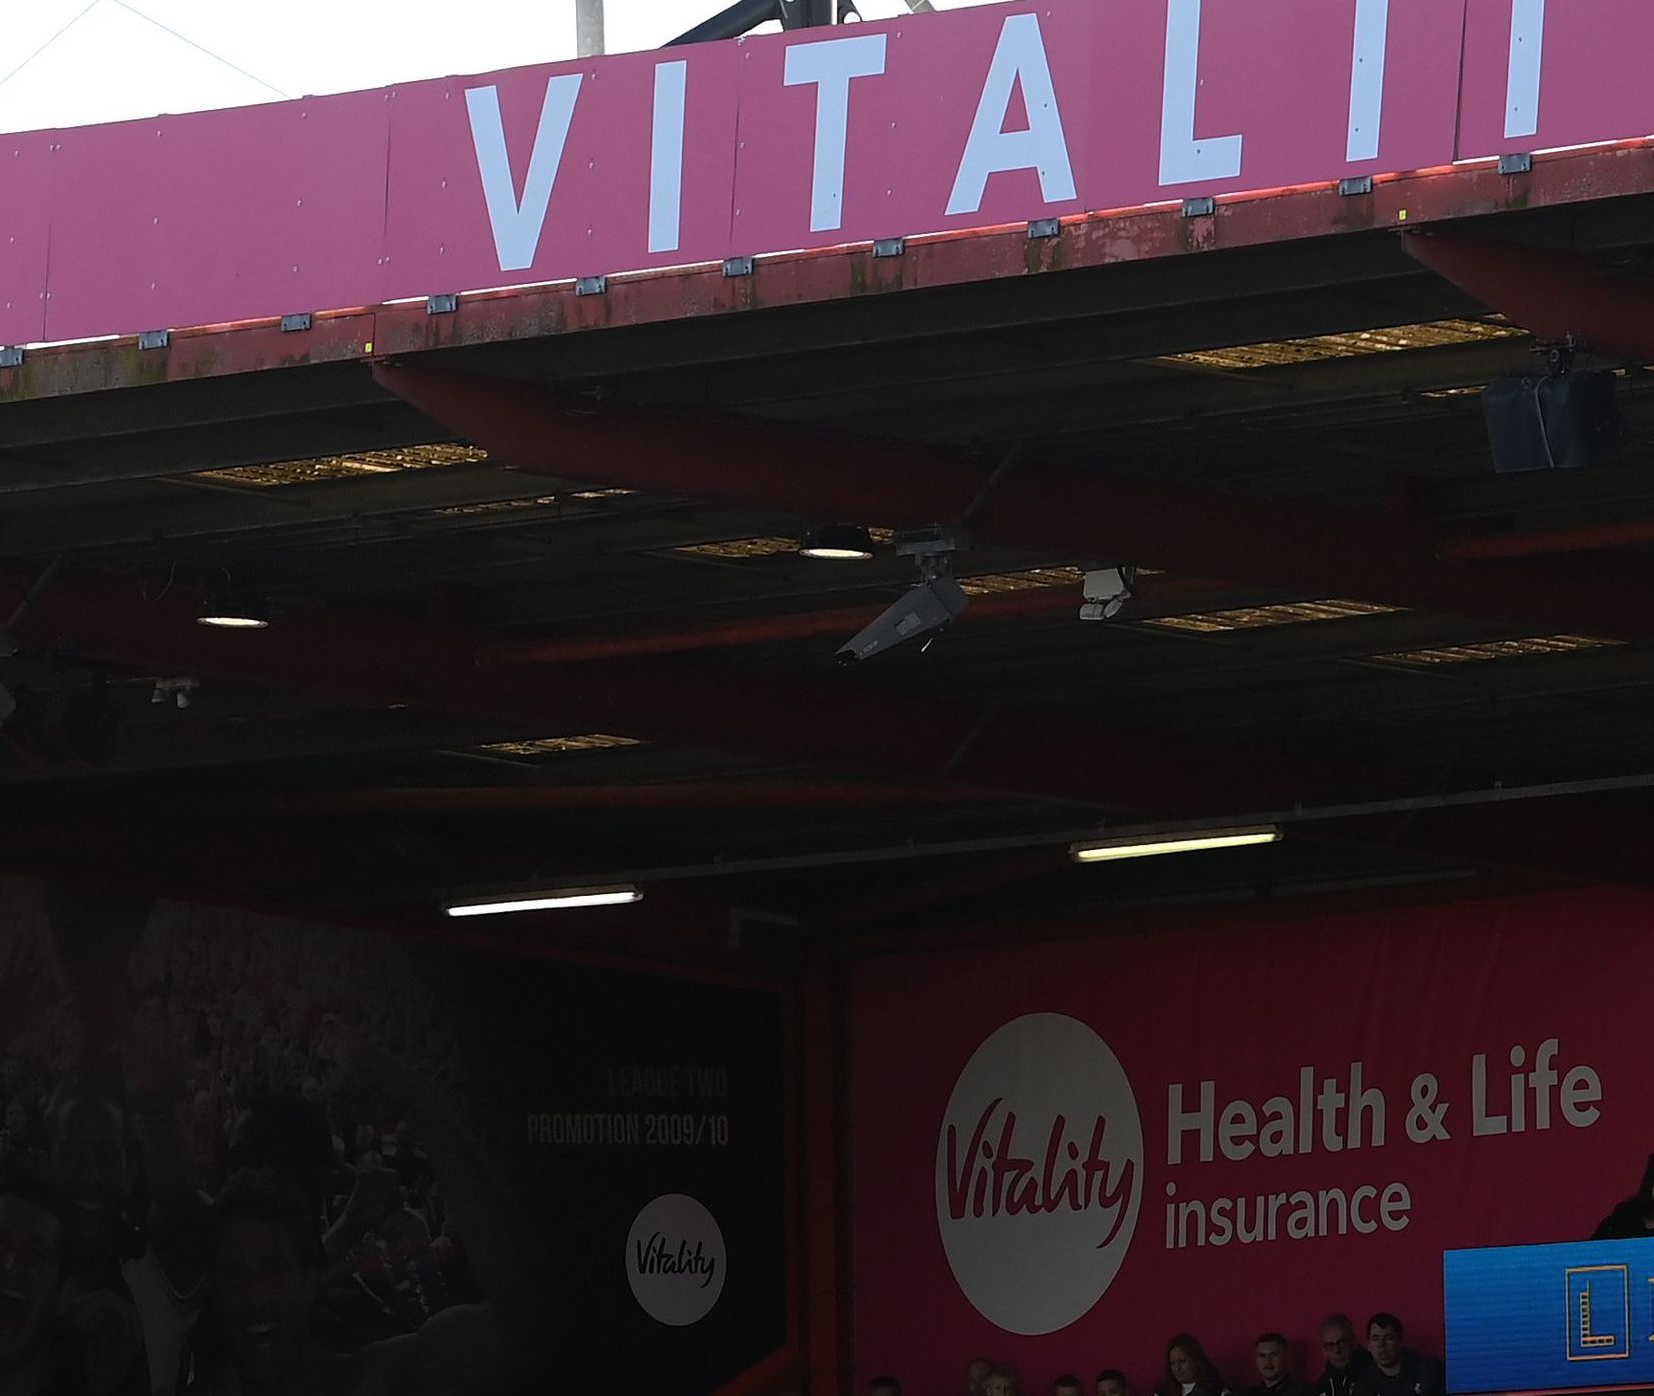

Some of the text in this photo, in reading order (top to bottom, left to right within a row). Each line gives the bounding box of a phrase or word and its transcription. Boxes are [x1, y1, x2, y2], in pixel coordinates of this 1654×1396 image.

[608, 1066, 727, 1097] LEAGUE TWO
[1167, 1038, 1601, 1165] Health & Life
[527, 1113, 729, 1146] PROMOTION 2009/10
[947, 1097, 1134, 1248] Vitality
[1166, 1180, 1411, 1249] insurance
[636, 1231, 716, 1288] Vitality
